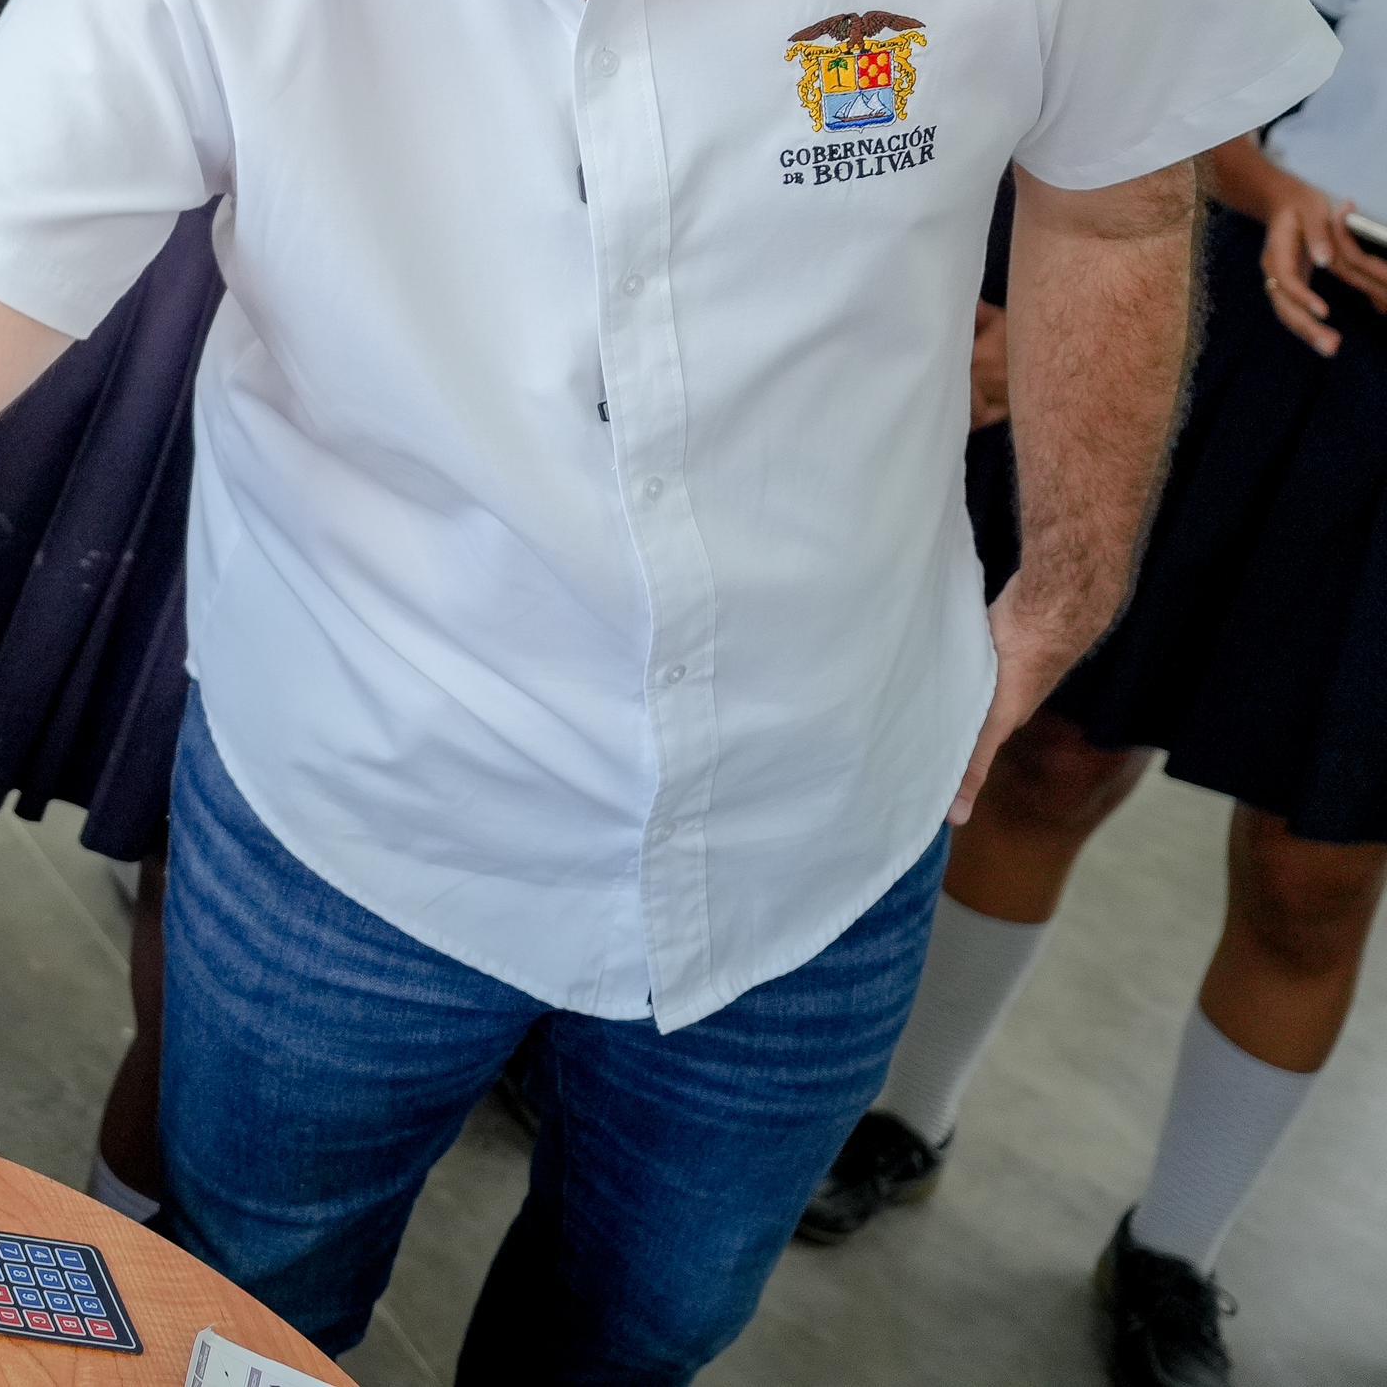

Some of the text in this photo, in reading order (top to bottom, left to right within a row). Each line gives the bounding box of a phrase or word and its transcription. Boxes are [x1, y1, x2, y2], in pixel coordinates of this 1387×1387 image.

[779, 125, 938, 168] GOBERNACIÓN
[783, 171, 805, 185] DE
[4, 1247, 46, 1325] 7 8 9 C
[34, 1250, 77, 1329] 4 5 6 B
[74, 1277, 87, 1286] 2
[84, 1301, 97, 1310] 3
[94, 1323, 108, 1331] A
[1, 1311, 15, 1320] D
